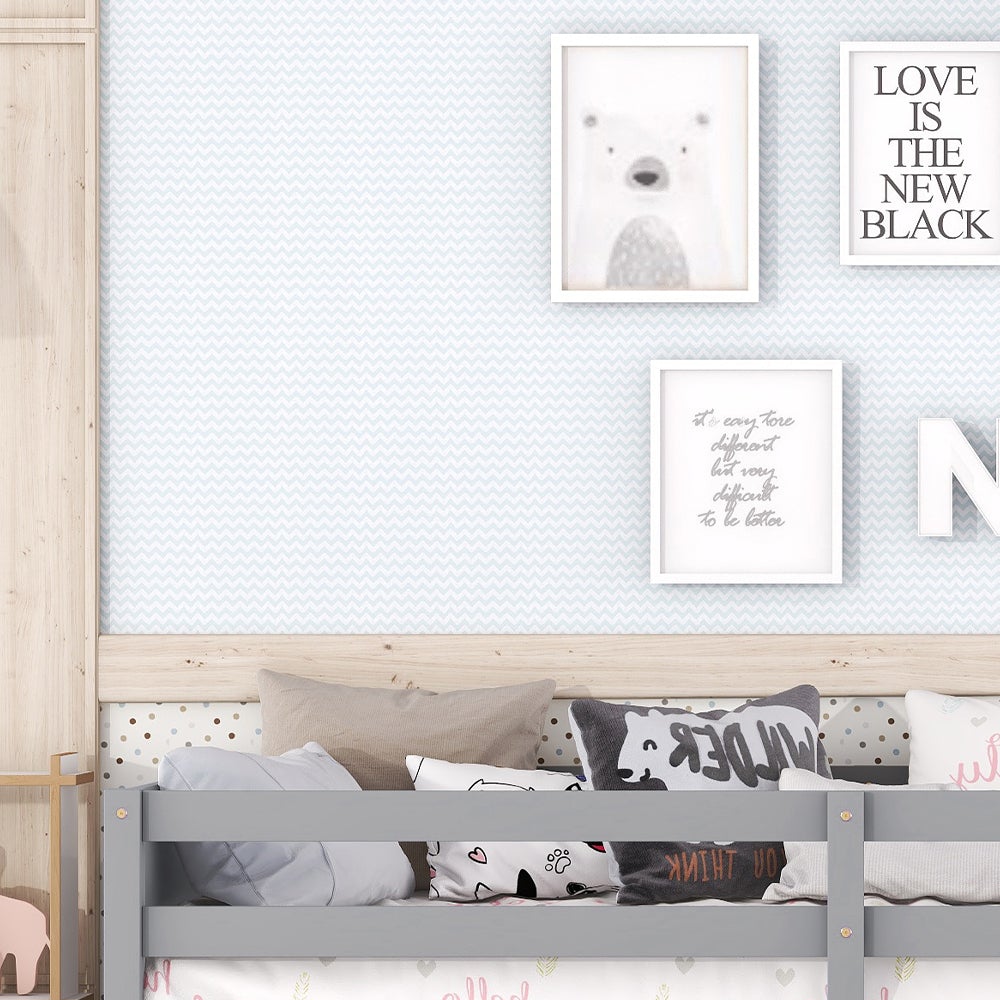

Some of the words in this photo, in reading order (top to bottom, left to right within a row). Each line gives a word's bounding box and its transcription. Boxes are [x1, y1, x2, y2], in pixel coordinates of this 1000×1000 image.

[873, 65, 979, 96] LOVE
[908, 101, 942, 132] IS
[887, 137, 965, 168] THE
[879, 173, 972, 204] NEW
[859, 209, 995, 240] BLACK
[711, 433, 781, 462] different
[711, 457, 741, 477] but
[740, 466, 778, 489] very
[712, 482, 779, 513] difficult
[697, 509, 716, 527] to
[723, 508, 741, 527] be
